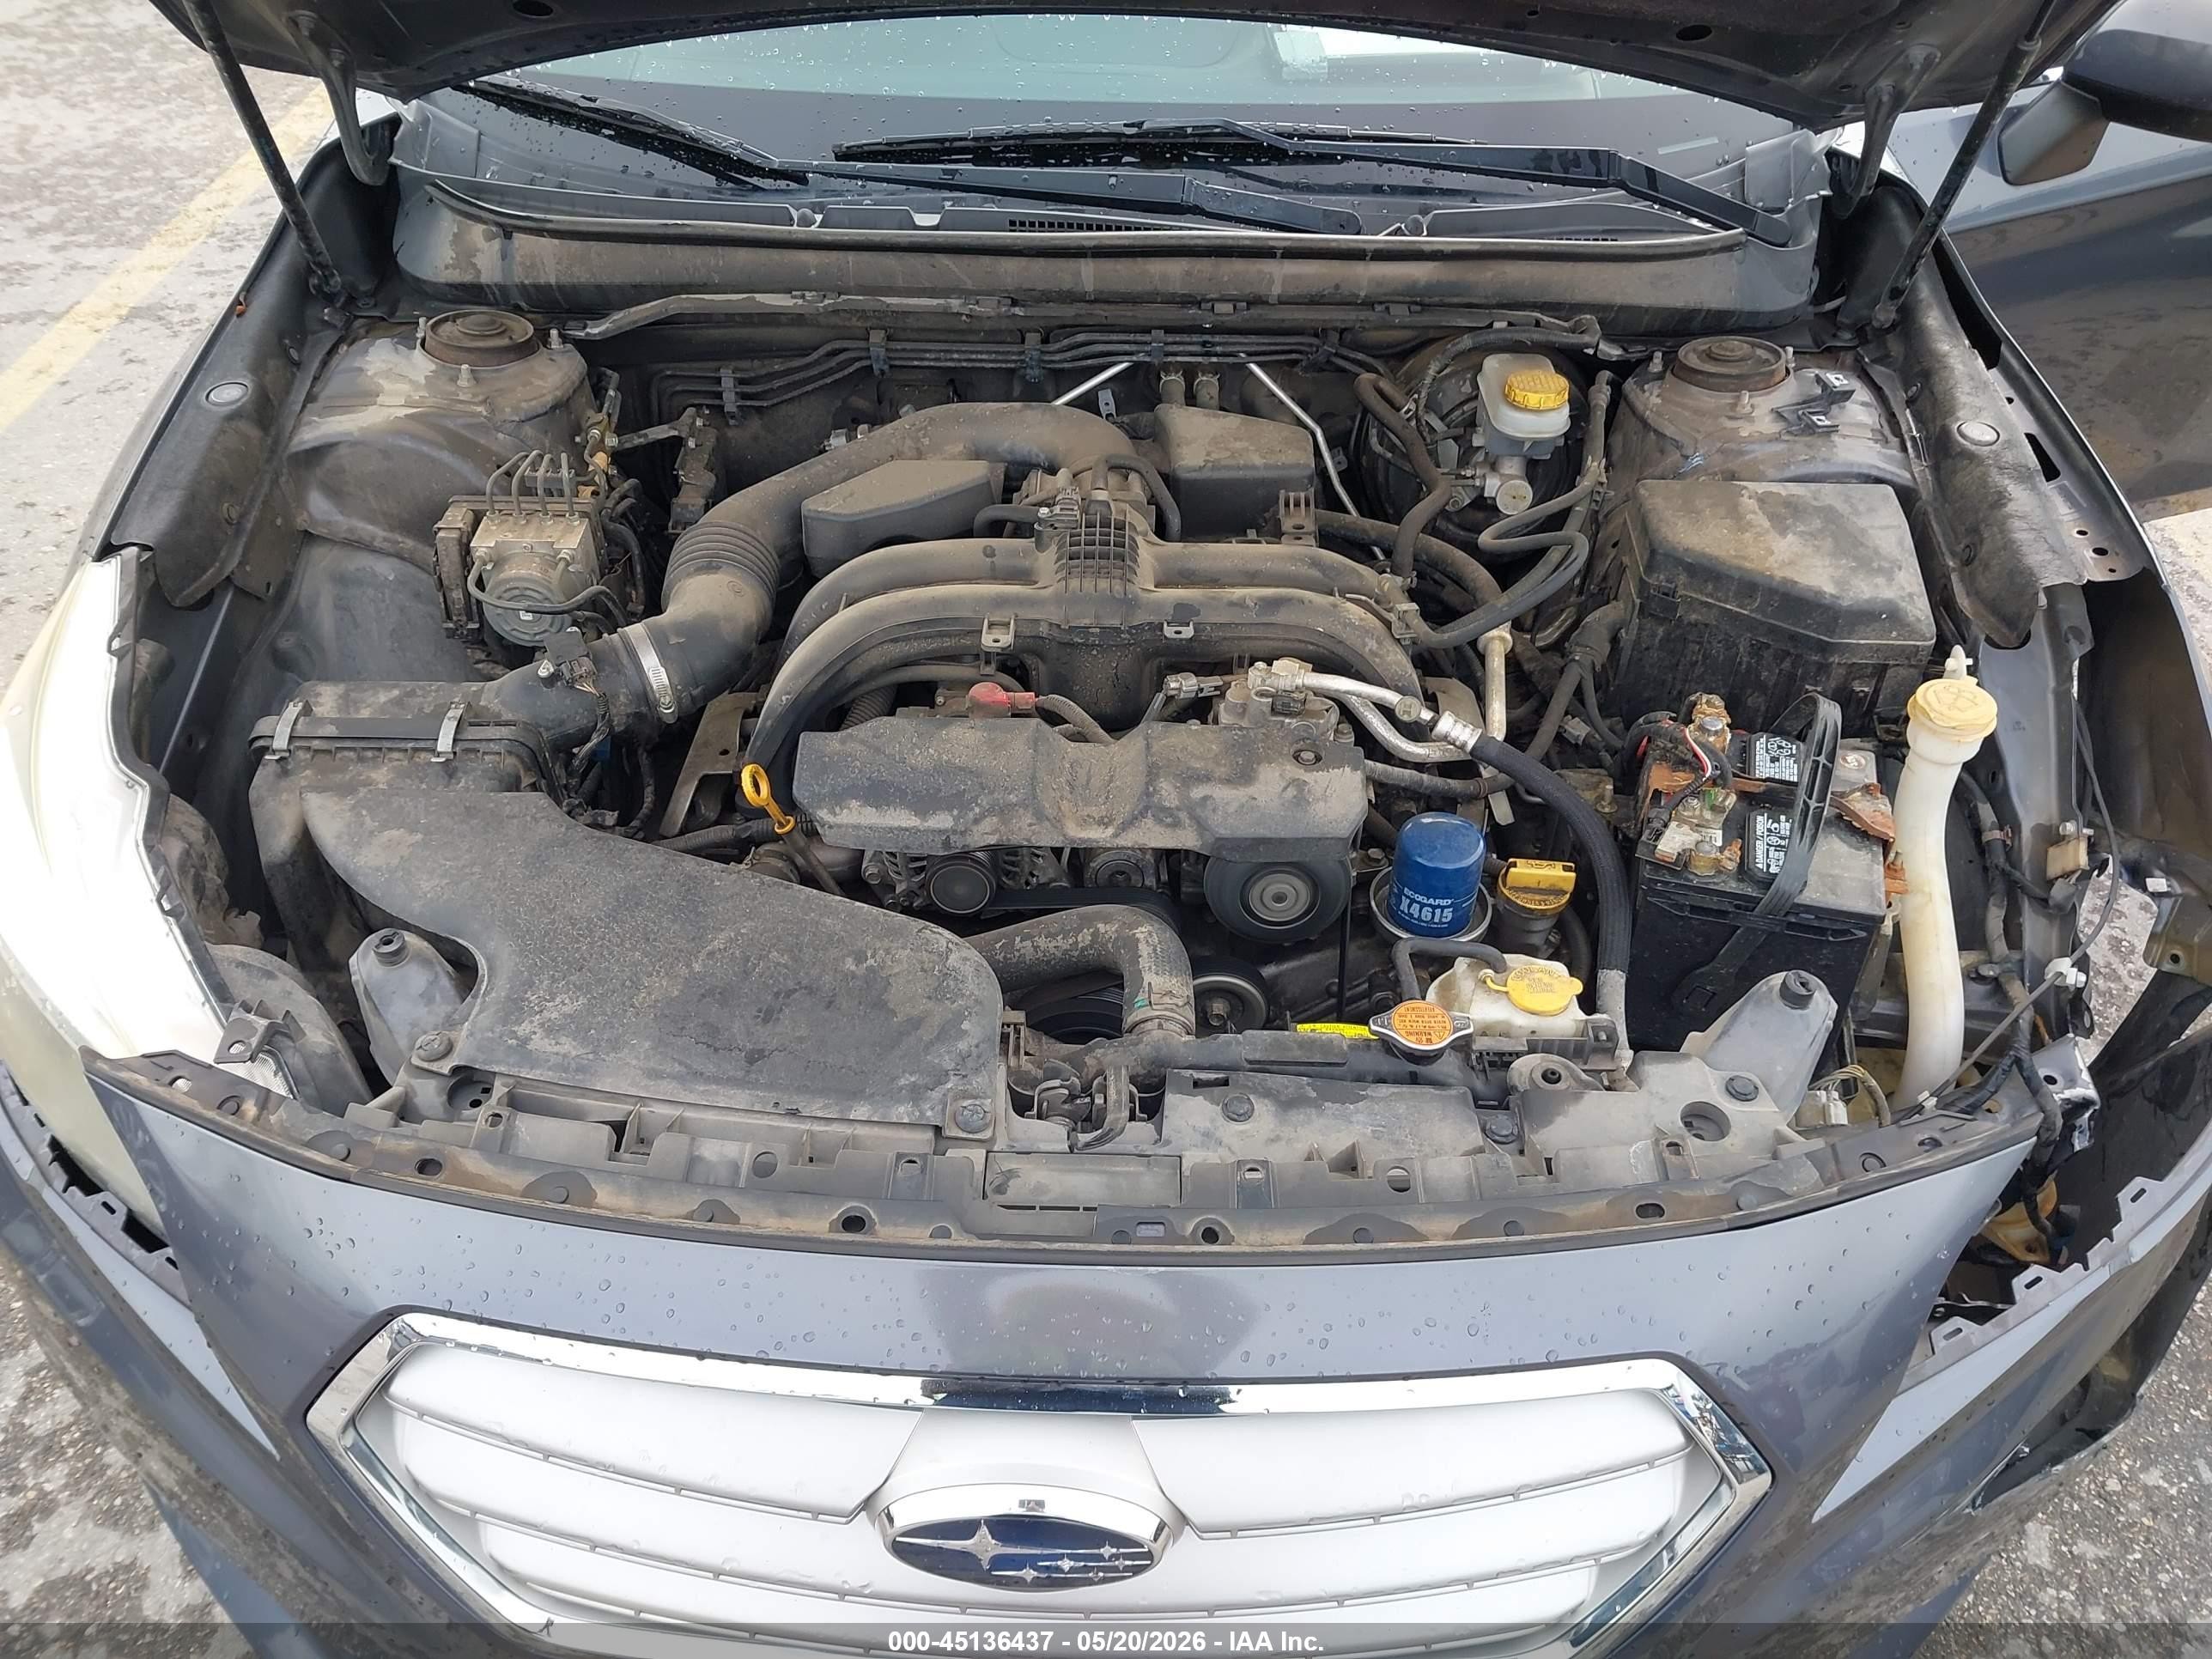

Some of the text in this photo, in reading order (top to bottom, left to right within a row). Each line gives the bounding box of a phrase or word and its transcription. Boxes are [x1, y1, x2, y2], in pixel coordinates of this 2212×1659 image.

[1756, 815, 1765, 836] POISON
[1755, 840, 1764, 864] DANGER
[1403, 887, 1452, 906] ECOGARD
[1400, 895, 1454, 923] X4615
